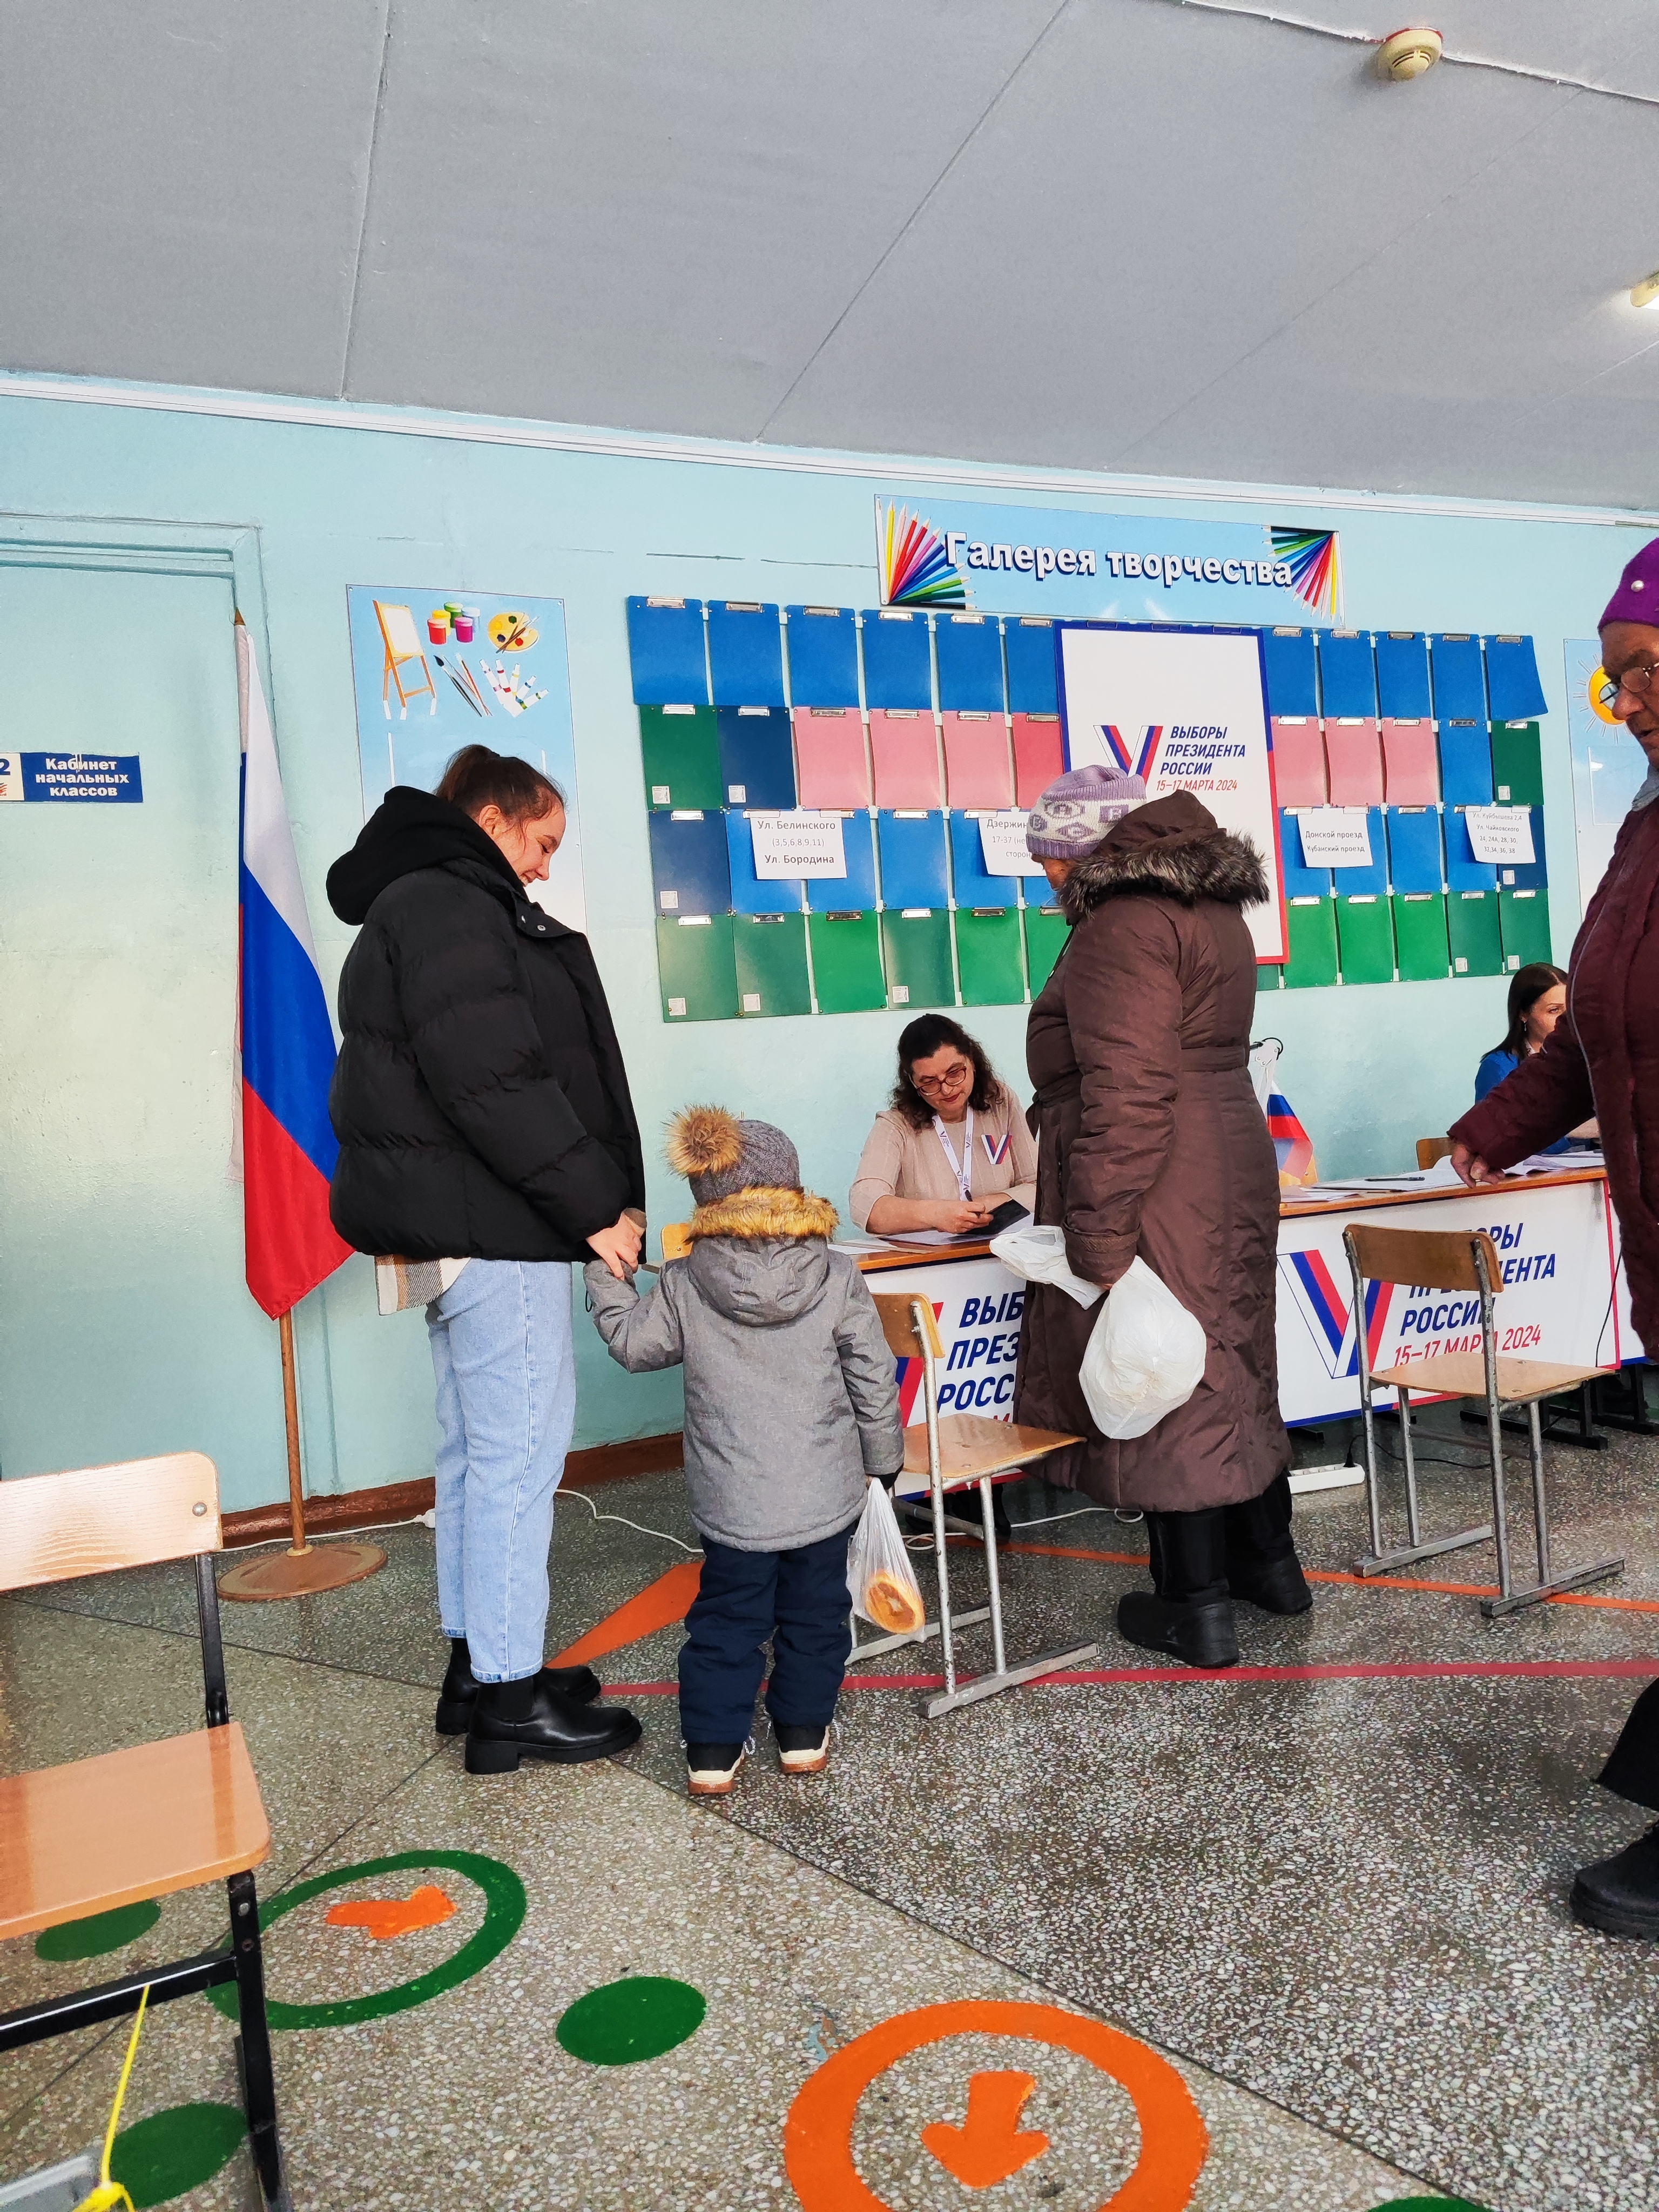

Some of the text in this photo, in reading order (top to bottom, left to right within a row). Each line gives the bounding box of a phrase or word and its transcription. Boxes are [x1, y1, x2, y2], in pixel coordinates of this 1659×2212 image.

[945, 531, 1293, 589] Галерея творчества
[1170, 726, 1228, 739] ВЫБОРЫ
[1165, 744, 1245, 759] ПРЕЗИДЕНТА
[45, 757, 117, 771] Кабинет
[1160, 763, 1212, 775] РОССИИ
[35, 773, 130, 784] начальных
[1183, 780, 1213, 791] МАРТА
[1216, 779, 1238, 791] 2024
[50, 787, 118, 797] классов
[758, 821, 835, 830] Ул. Белинского
[992, 835, 1012, 844] 17-37
[1306, 831, 1335, 839] Донской
[1006, 851, 1030, 859] сторон
[1307, 845, 1339, 853] Кубанский
[764, 855, 834, 865] Ул. Бородина
[959, 1290, 1026, 1328] ВЫБ
[1502, 1324, 1541, 1351] 2024
[938, 1373, 1015, 1414] РОСС
